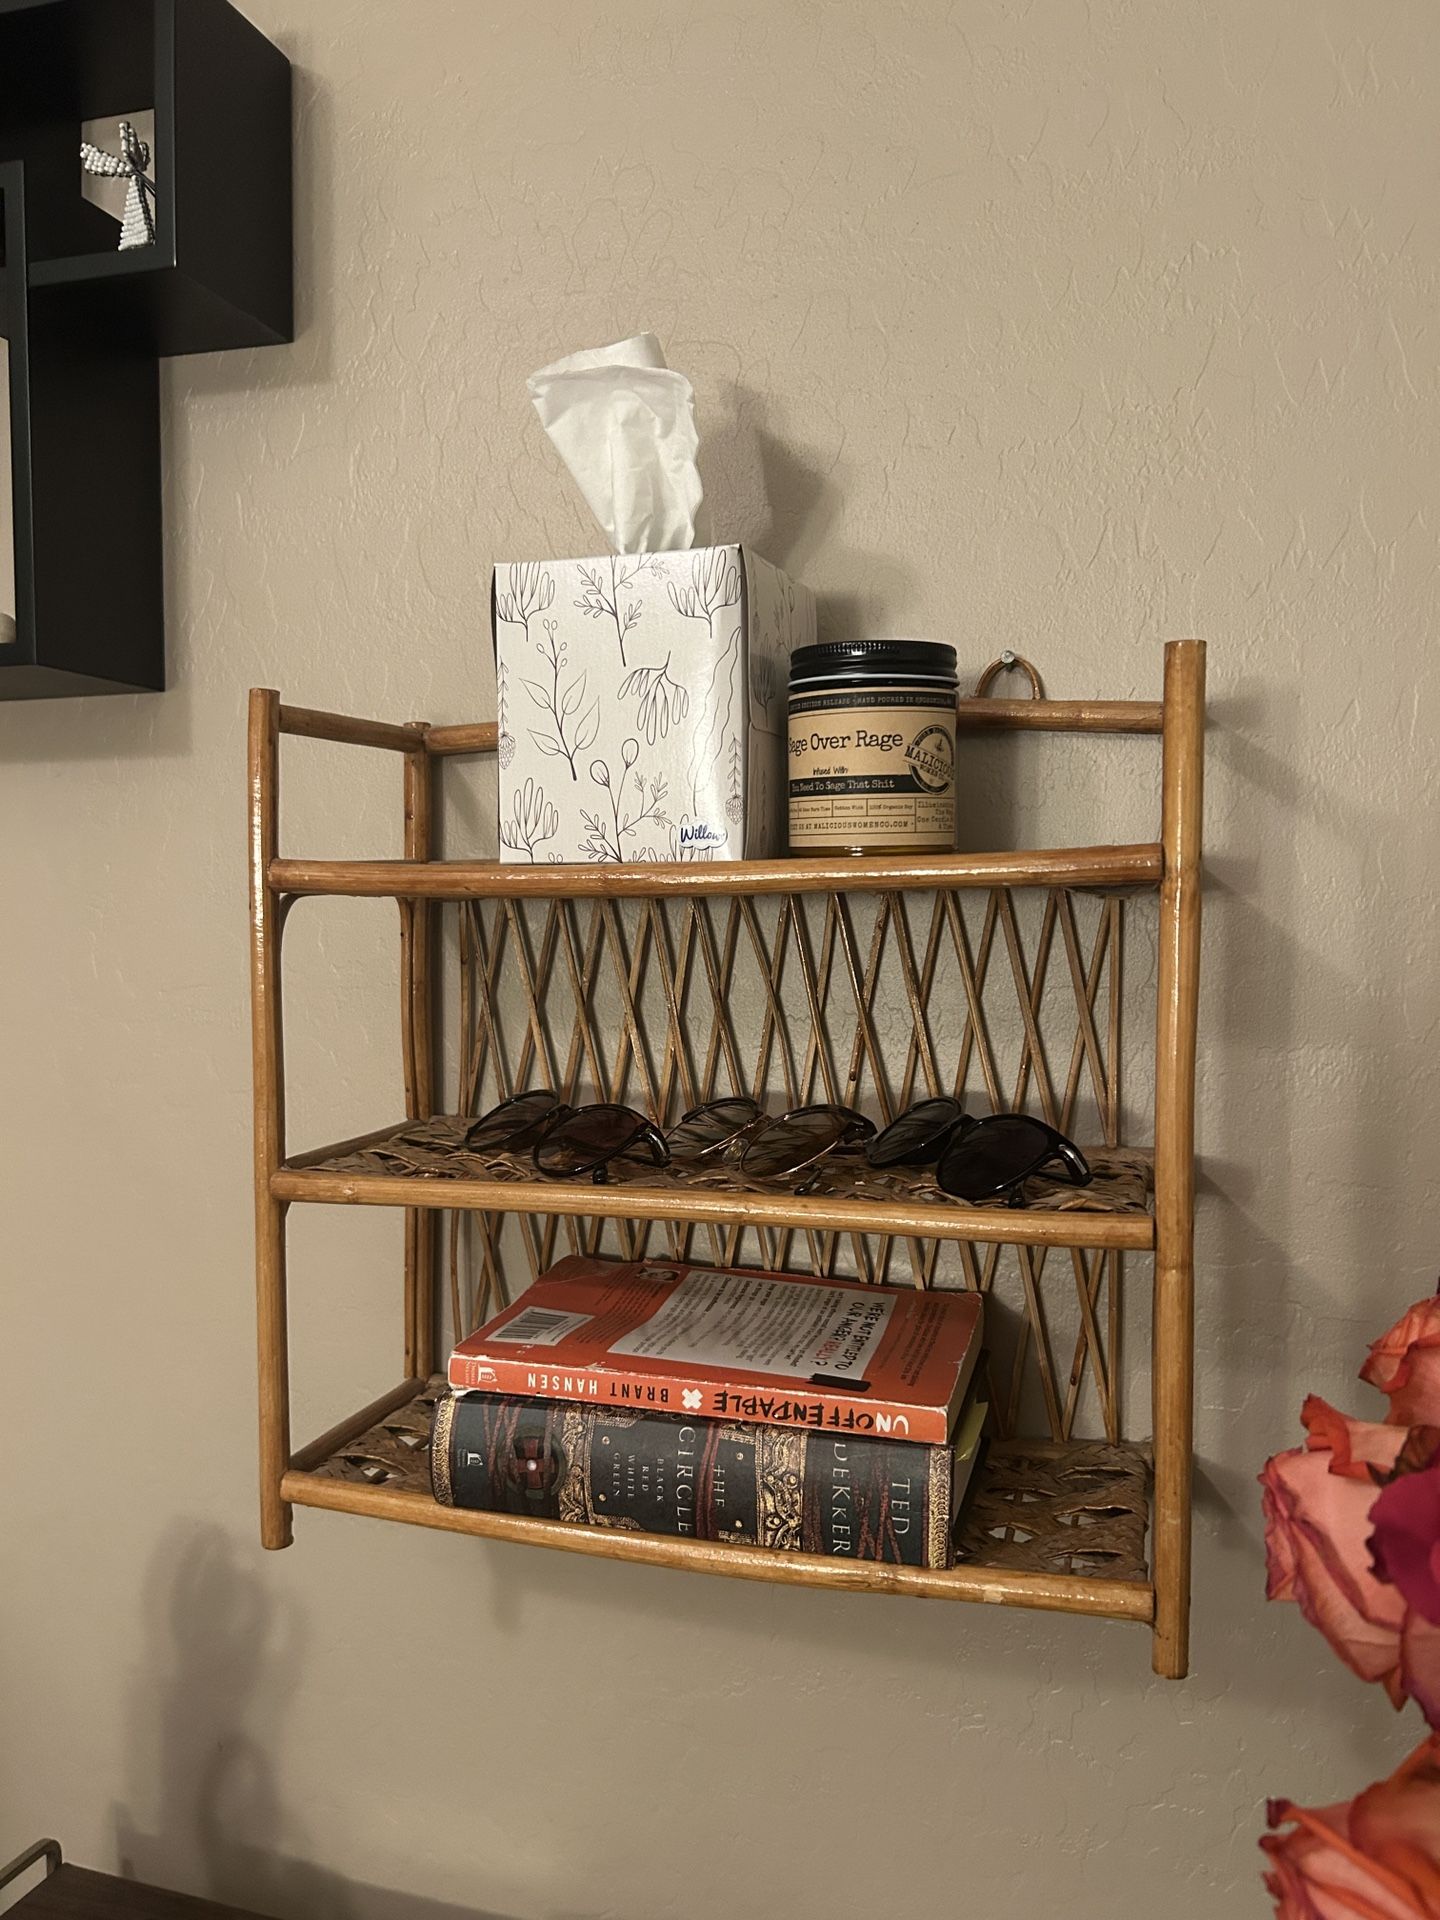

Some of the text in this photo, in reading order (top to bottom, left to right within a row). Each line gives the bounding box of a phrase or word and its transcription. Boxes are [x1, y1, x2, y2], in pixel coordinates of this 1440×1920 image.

[810, 733, 851, 751] Over
[855, 729, 904, 752] Rage
[812, 765, 848, 776] Infused With
[815, 781, 824, 790] To
[825, 780, 846, 792] Sage
[847, 779, 870, 790] That
[871, 779, 895, 789] Shit
[846, 1301, 865, 1318] OUR
[859, 1321, 877, 1336] NOT
[834, 1360, 853, 1371] TO
[527, 1372, 910, 1435] UNOFFENDABLE BRANT HANSEN
[612, 1452, 621, 1497] GREEN
[626, 1454, 636, 1499] WHITE
[641, 1465, 650, 1492] RED
[656, 1458, 665, 1502] BLACK
[675, 1426, 697, 1533] CIRCLE
[712, 1464, 726, 1508] THE
[831, 1442, 851, 1553] DEKKER
[890, 1478, 911, 1535] TED
